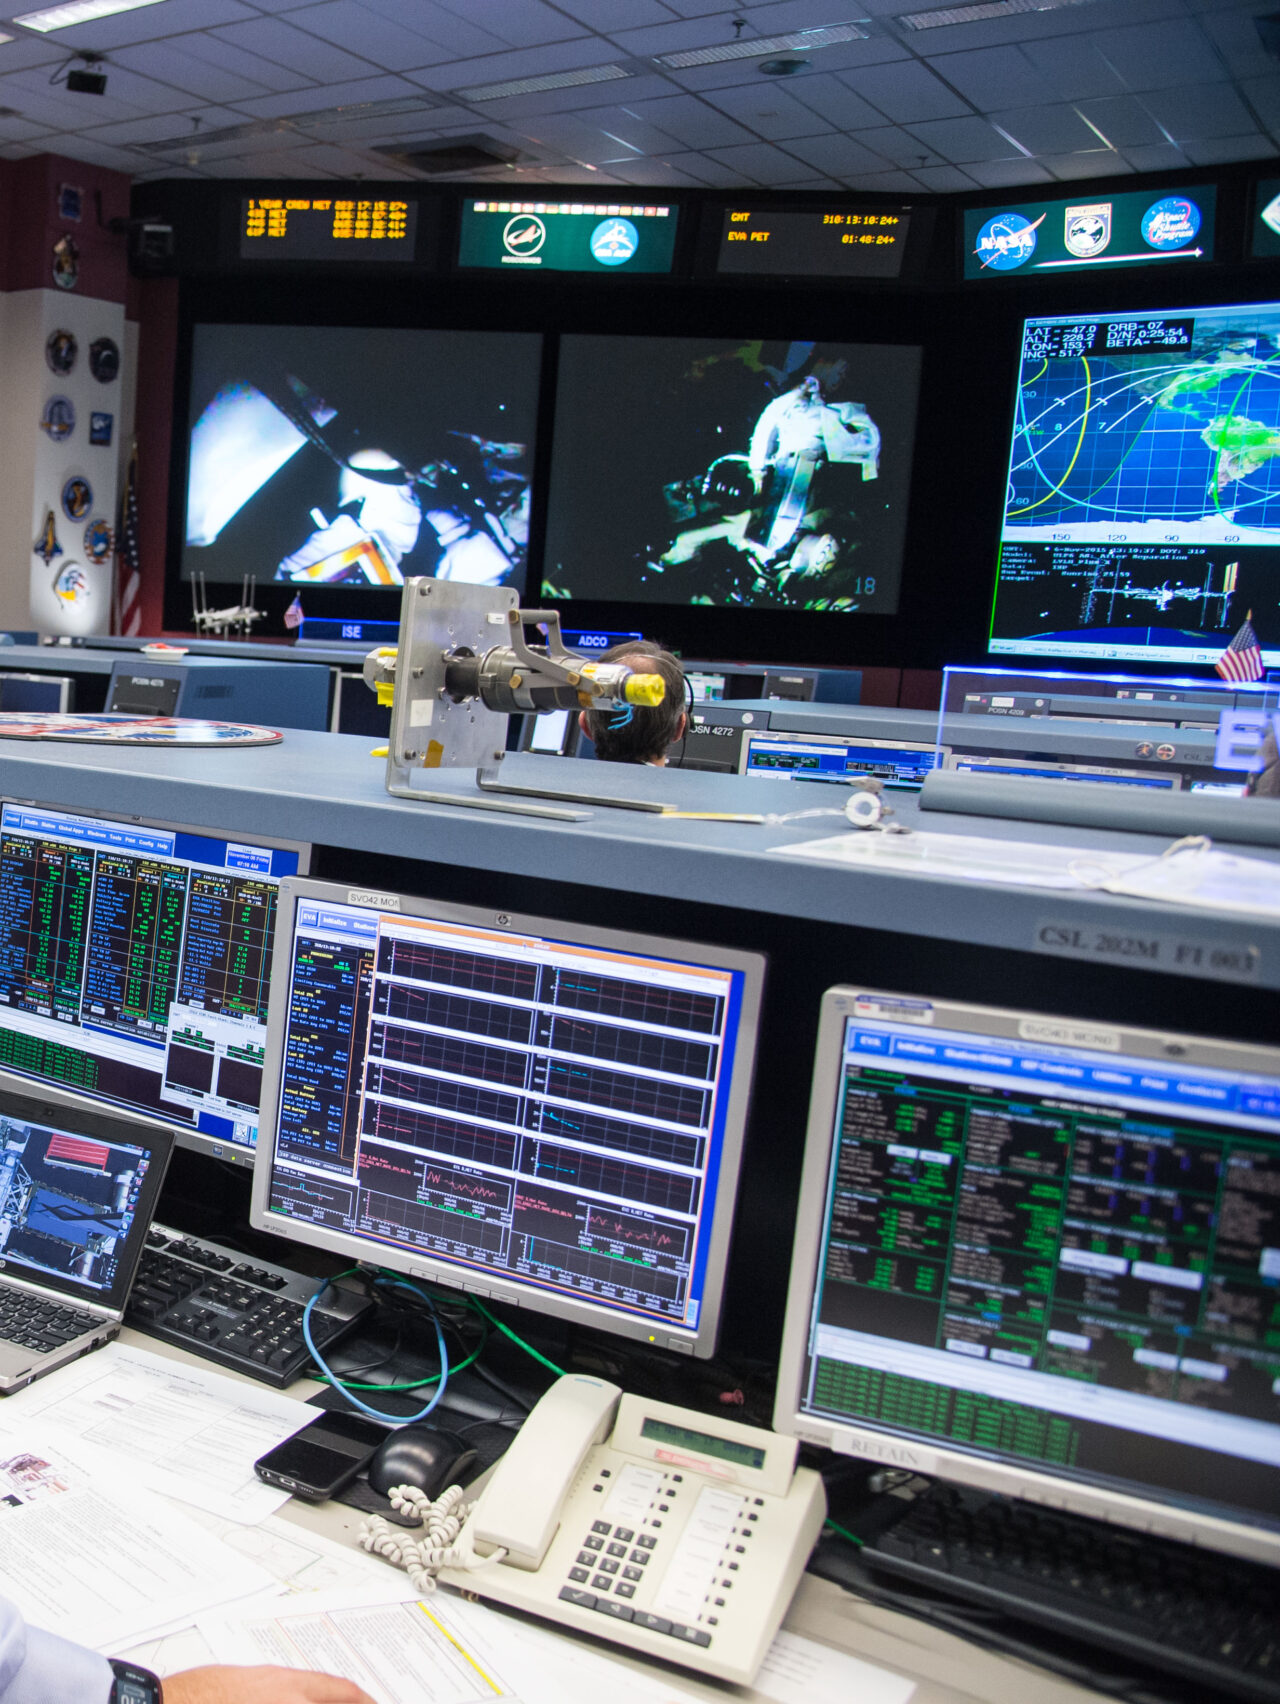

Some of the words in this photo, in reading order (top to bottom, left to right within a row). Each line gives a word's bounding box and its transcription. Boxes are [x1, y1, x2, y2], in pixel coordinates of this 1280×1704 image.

[981, 232, 1033, 251] NASA
[1147, 321, 1164, 330] 07
[1026, 327, 1051, 336] LAT
[1138, 328, 1184, 339] 0:25:54
[1025, 335, 1050, 344] ALT
[1062, 333, 1096, 343] 228.2
[1063, 341, 1093, 350] 153.1
[1024, 350, 1047, 360] INC
[1058, 349, 1084, 358] 51.7
[1054, 424, 1062, 432] 8
[1098, 422, 1107, 430] 7
[854, 576, 876, 596] 18
[342, 624, 362, 638] ISE
[578, 636, 608, 648] ADCO
[690, 725, 710, 734] OSN
[712, 726, 734, 736] 4272
[110, 834, 122, 842] Tools
[125, 836, 136, 844] Print
[138, 839, 154, 848] Config
[157, 842, 168, 850] Help
[350, 892, 378, 906] SVO42
[323, 918, 348, 927] Initialize
[300, 1091, 316, 1100] Battery
[304, 1158, 320, 1167] server
[322, 1163, 352, 1174] connection
[850, 1439, 919, 1466] RETAIN
